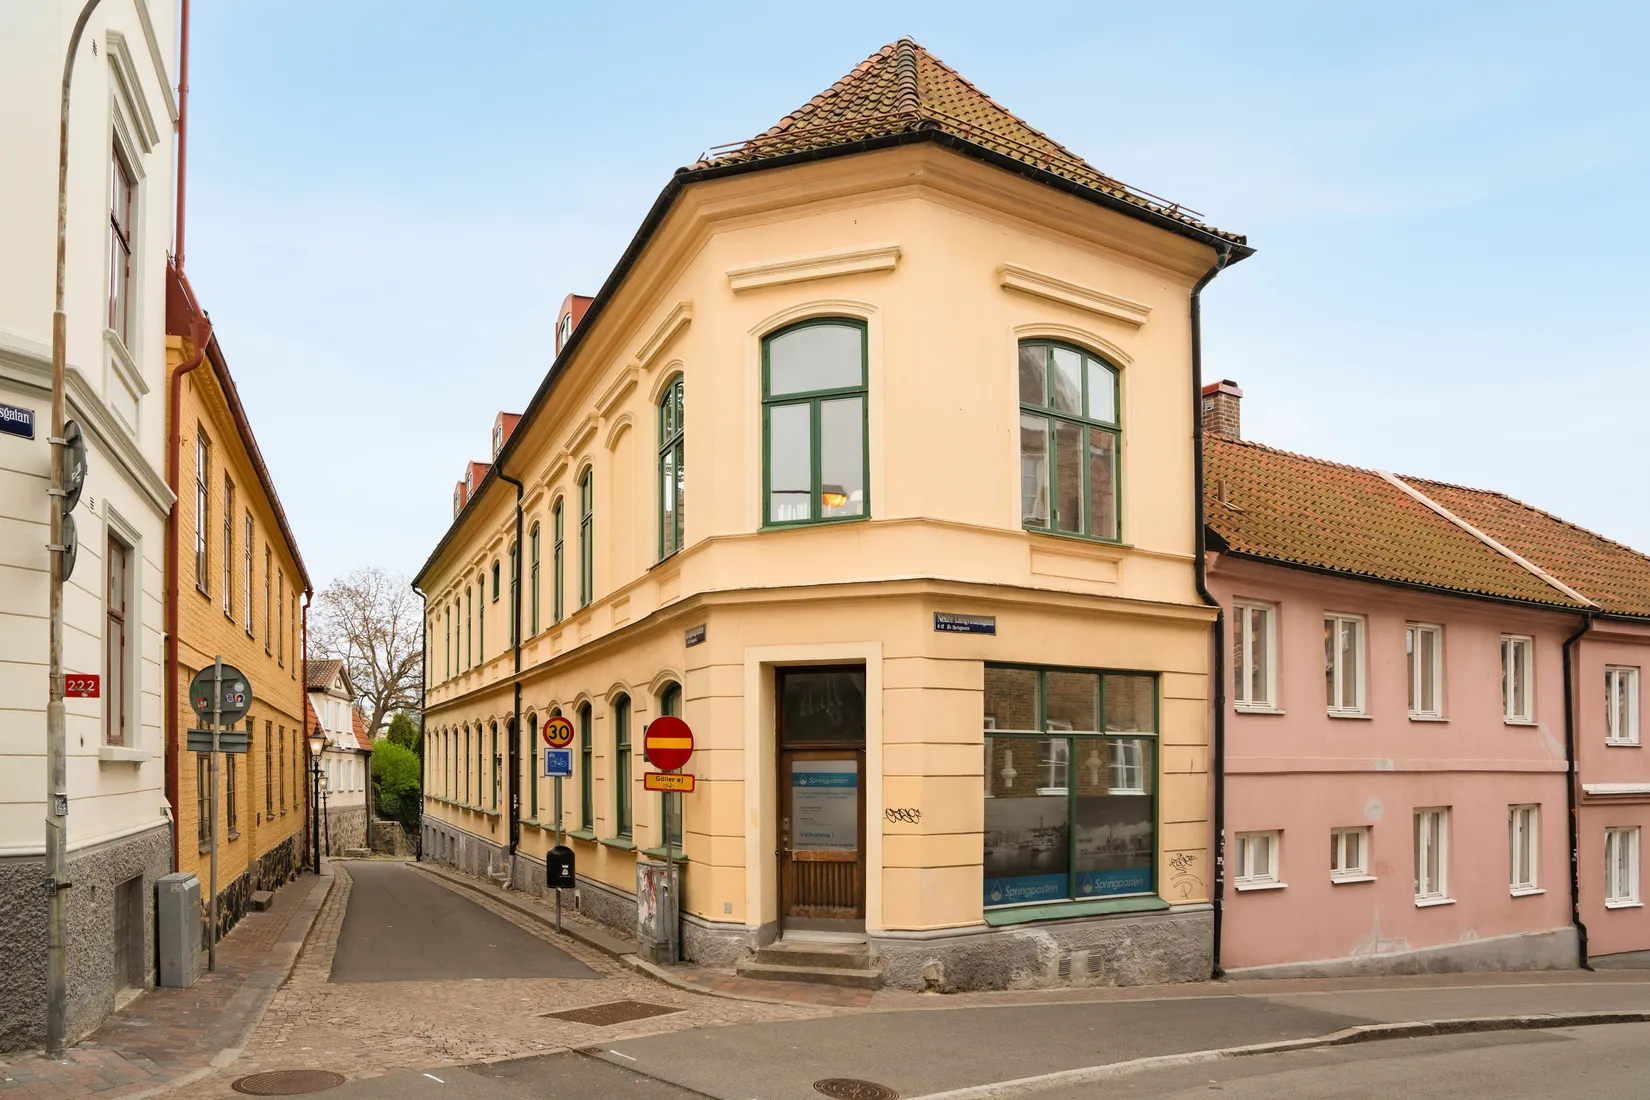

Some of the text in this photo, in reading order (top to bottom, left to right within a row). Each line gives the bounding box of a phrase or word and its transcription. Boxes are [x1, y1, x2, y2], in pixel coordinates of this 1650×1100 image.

[68, 680, 94, 691] 222
[549, 725, 569, 740] 30
[808, 776, 849, 785] Springposten
[1094, 877, 1143, 891] Springposten
[1004, 884, 1058, 899] Springposten
